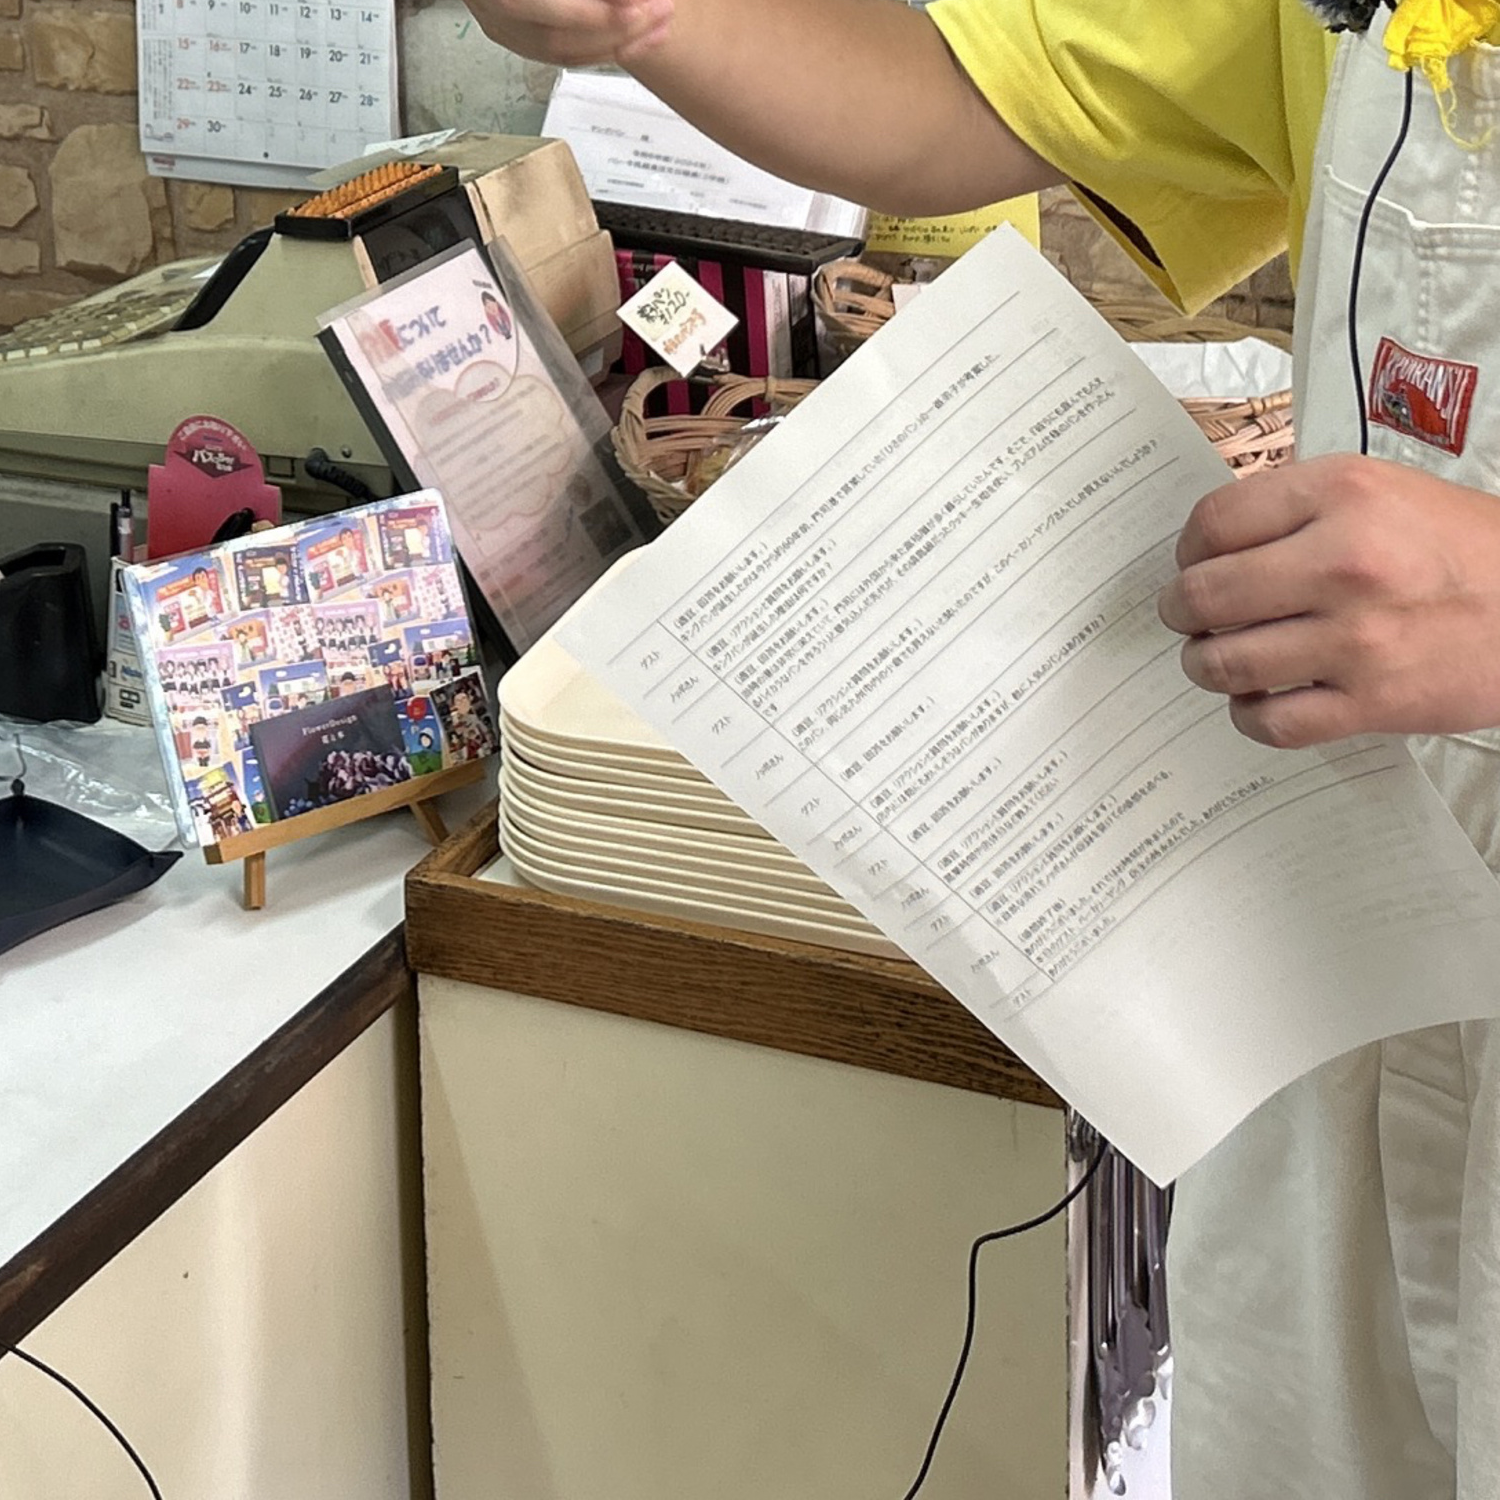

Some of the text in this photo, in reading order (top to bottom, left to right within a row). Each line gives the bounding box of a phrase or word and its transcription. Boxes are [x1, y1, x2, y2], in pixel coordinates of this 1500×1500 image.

[208, 0, 215, 10] 9
[239, 2, 250, 14] 10
[270, 4, 278, 15] 11
[300, 7, 311, 18] 12
[330, 9, 341, 20] 13
[361, 11, 372, 22] 14
[177, 38, 370, 64] 15 16 17 18 19 20 21
[177, 78, 373, 105] 22 23 24 25 26 27 28
[177, 119, 221, 132] 29 30
[301, 713, 359, 737] FlowerDesign
